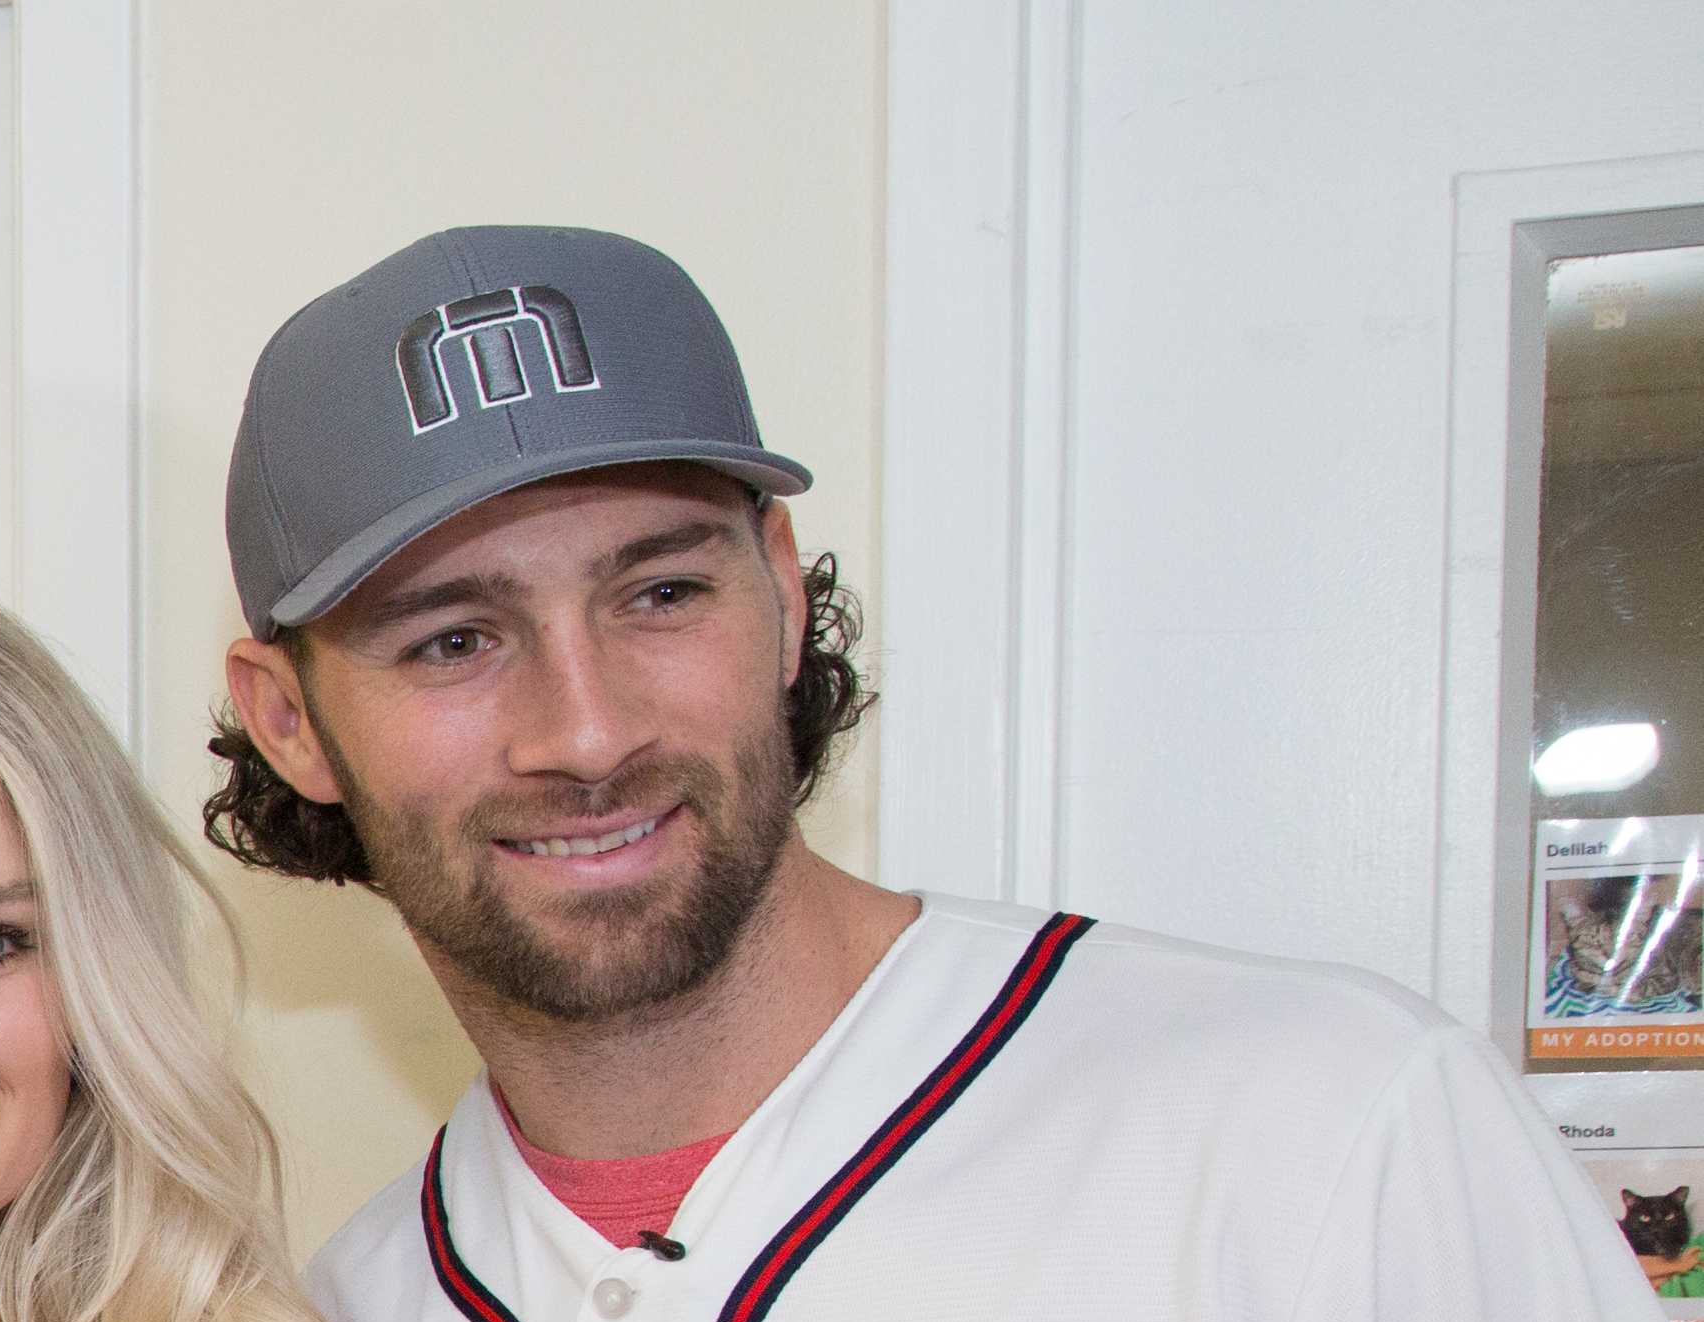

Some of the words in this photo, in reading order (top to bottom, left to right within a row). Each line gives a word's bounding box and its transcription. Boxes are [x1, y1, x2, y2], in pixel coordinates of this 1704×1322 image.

[1546, 841, 1608, 857] Delilah
[1541, 1032, 1575, 1048] MY
[1558, 1124, 1615, 1138] Rhoda
